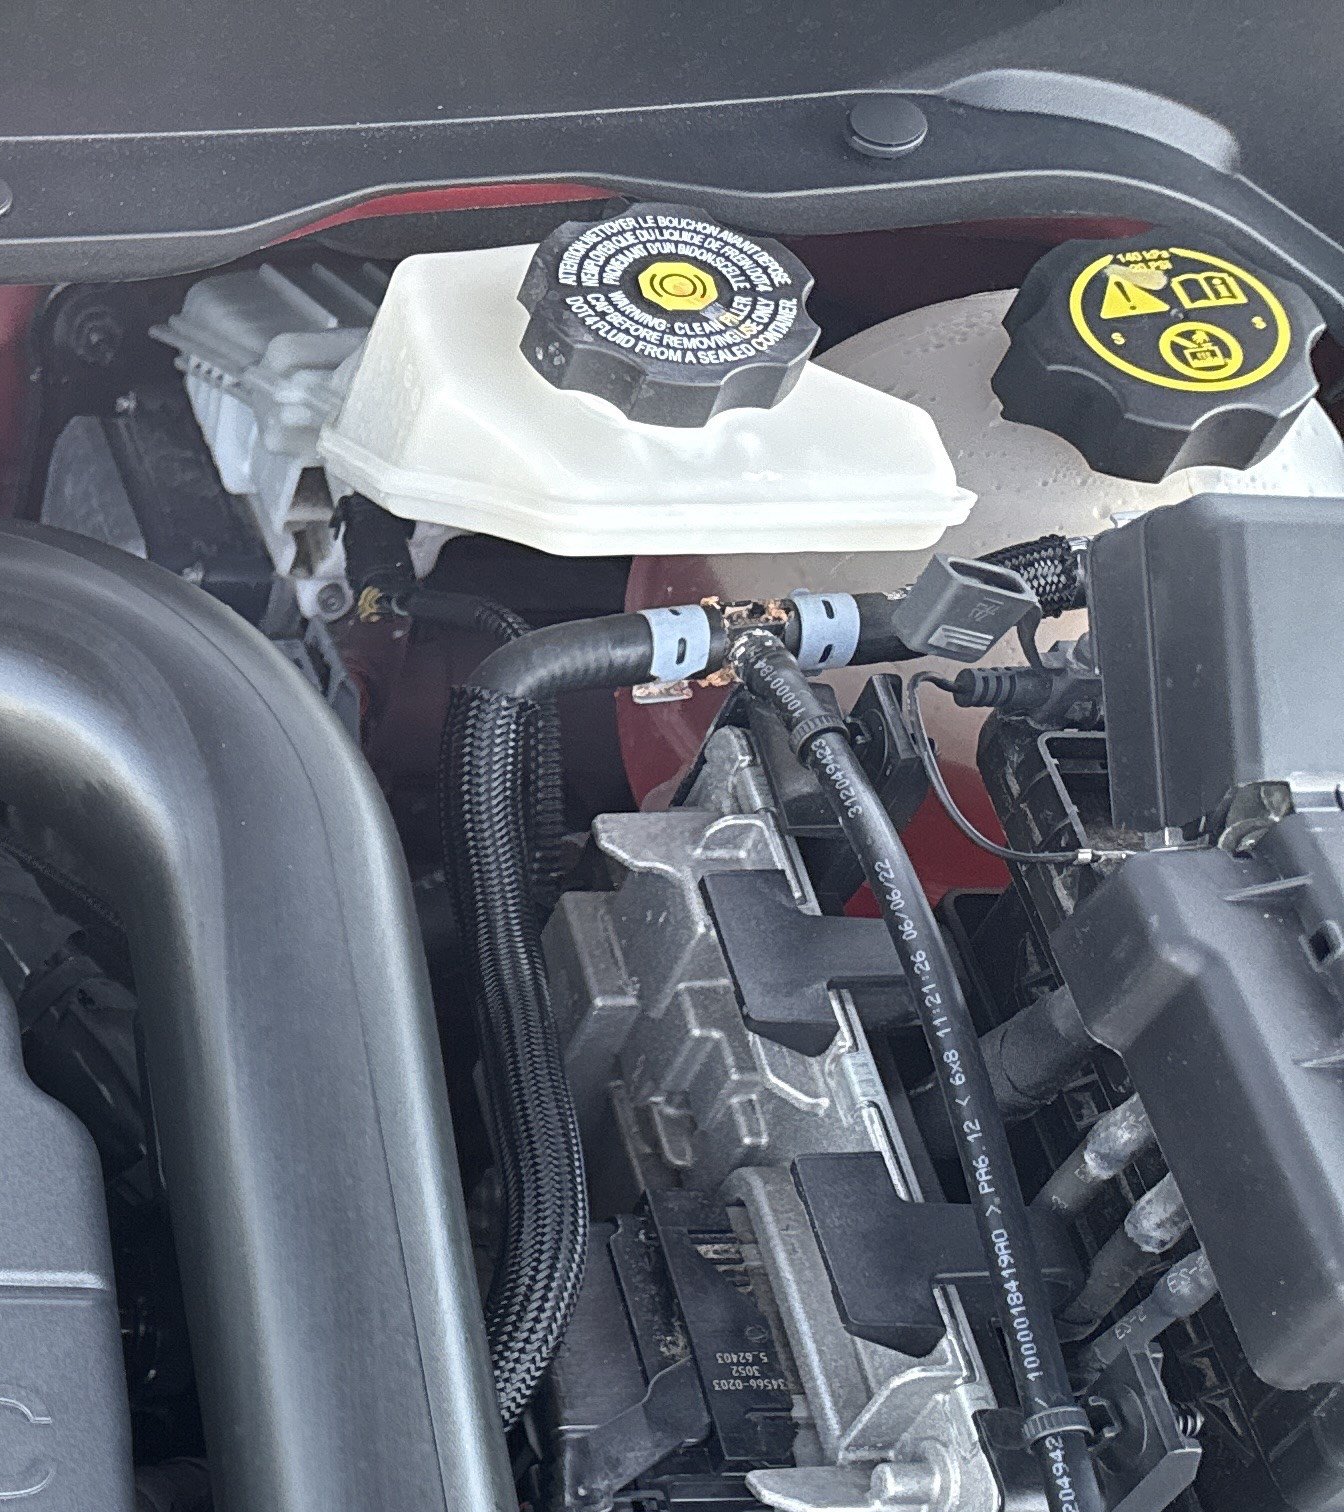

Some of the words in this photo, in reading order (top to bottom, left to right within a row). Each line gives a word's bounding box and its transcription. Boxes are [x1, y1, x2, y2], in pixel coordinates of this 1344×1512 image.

[611, 231, 640, 249] QUE
[635, 228, 656, 242] DU
[654, 228, 706, 246] LIQUIDE
[703, 238, 724, 252] DE
[637, 215, 657, 228] LE
[656, 215, 720, 237] BOUCHON
[717, 229, 761, 255] AVANT
[587, 293, 615, 313] CAP
[605, 311, 662, 344] BEFORE
[751, 296, 774, 323] ONLY
[608, 290, 671, 333] WARNING:
[673, 320, 726, 335] CLEAN
[590, 320, 636, 348] FLUID
[634, 340, 683, 363] FROM
[684, 350, 697, 364] A
[696, 343, 756, 364] SEALED
[810, 738, 863, 819] 312049423
[874, 858, 918, 942] 06/06/22
[729, 1365, 761, 1377] 3052
